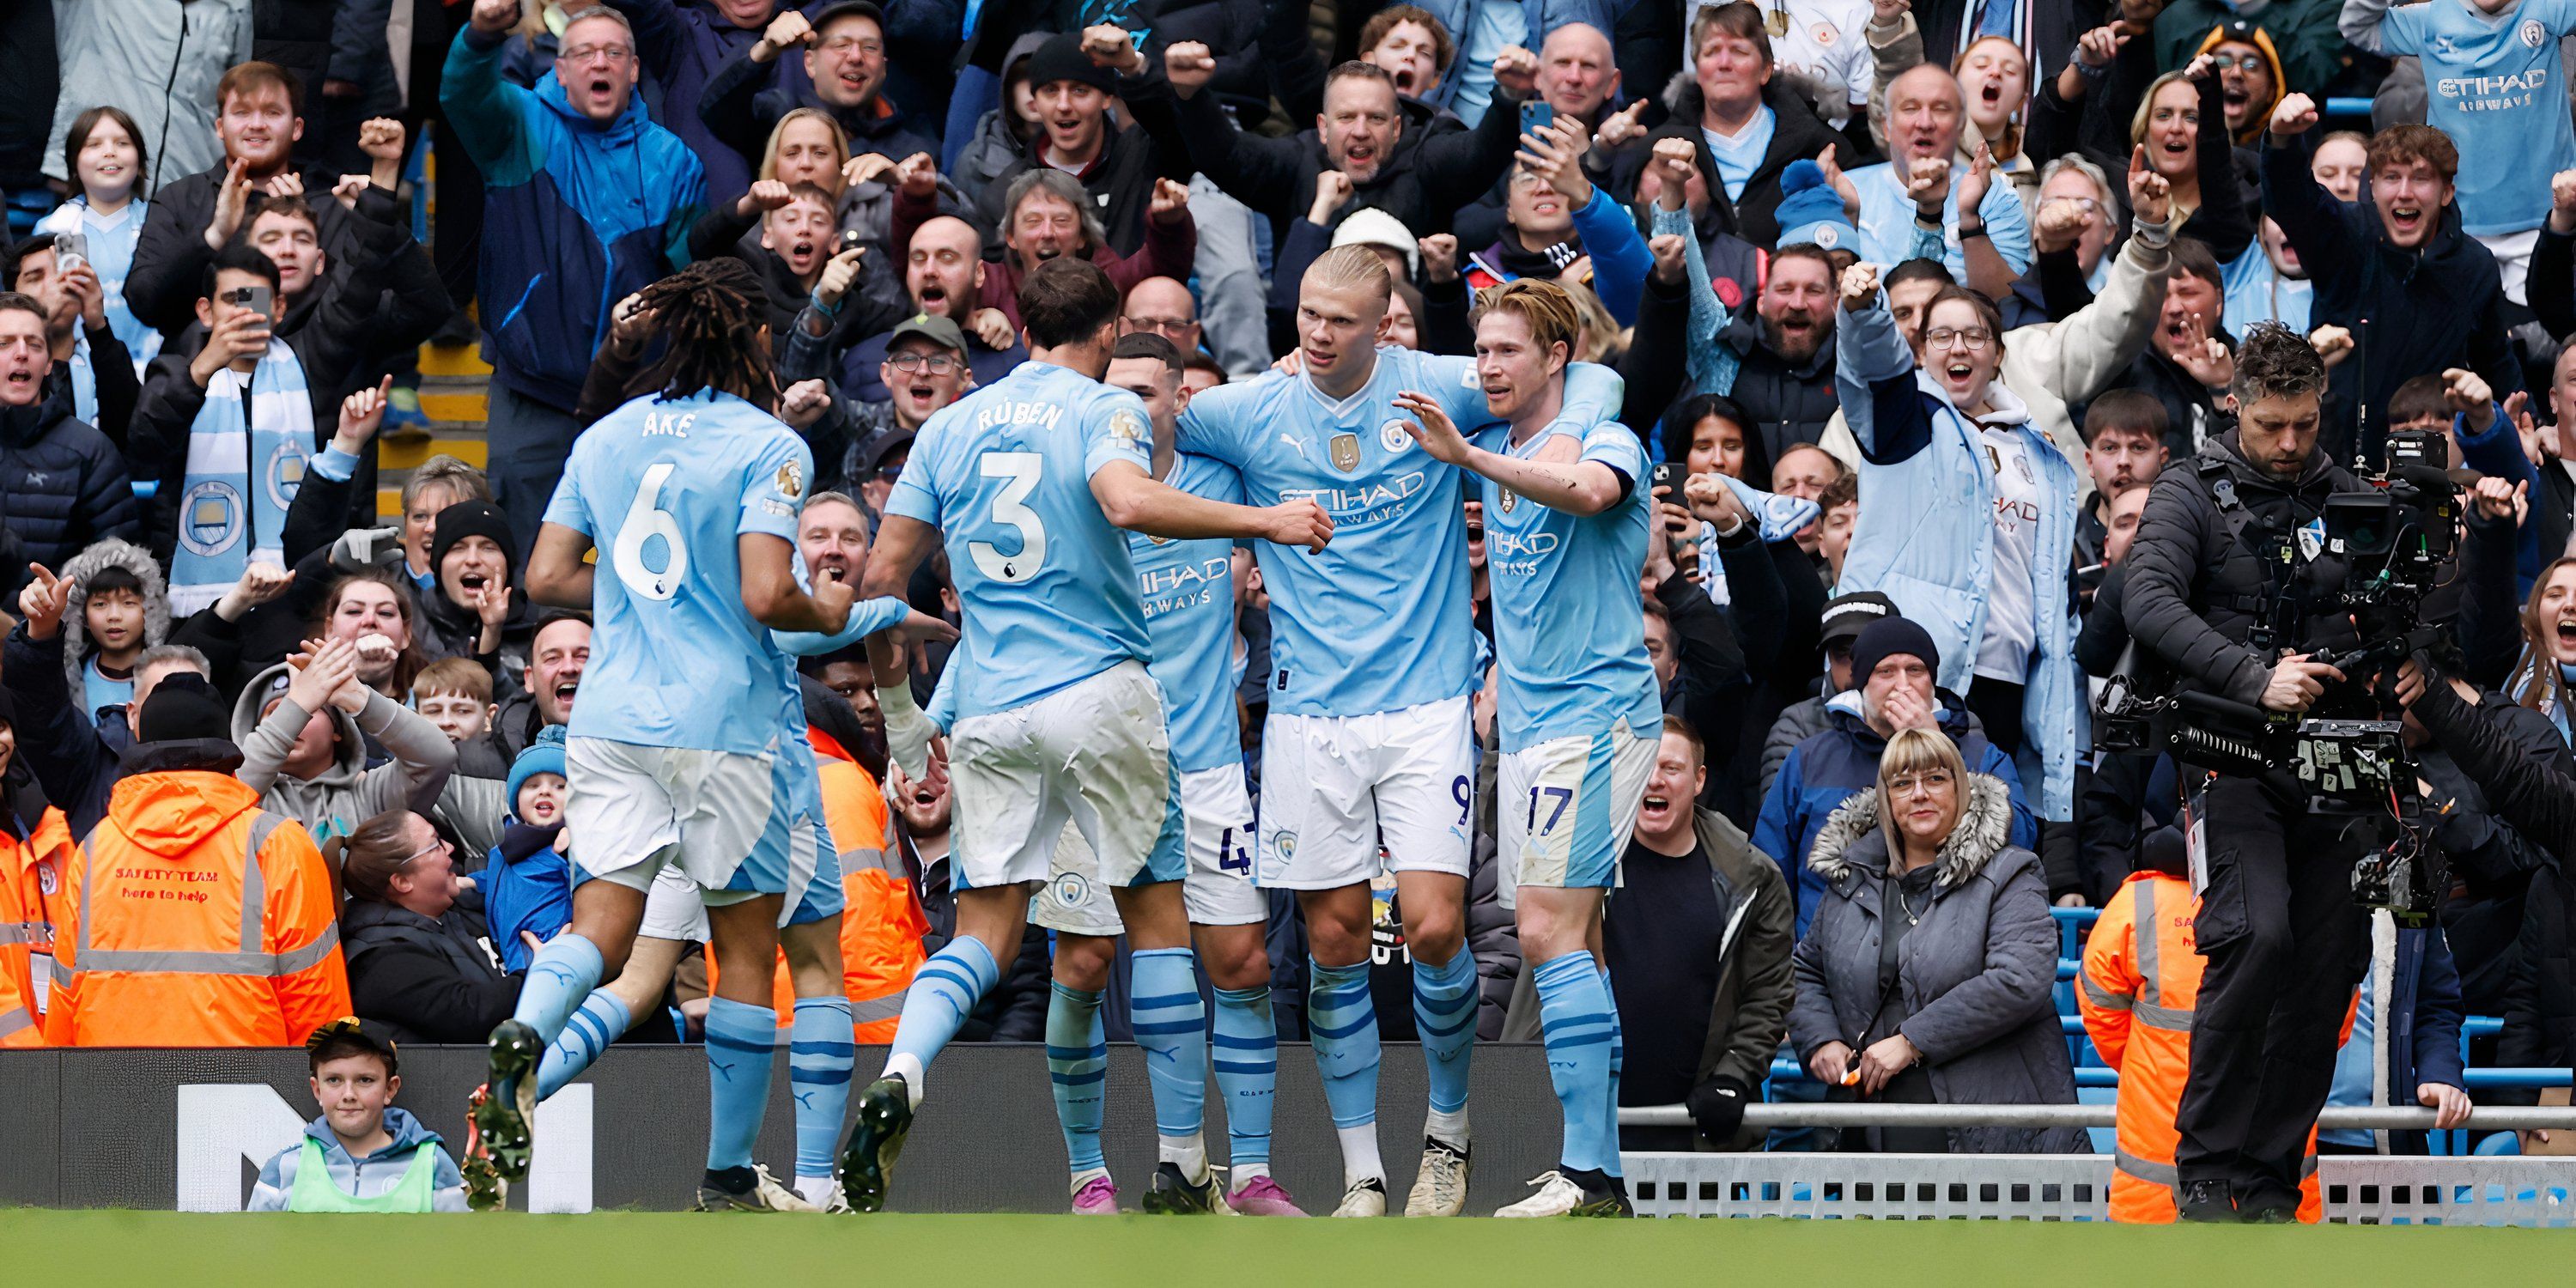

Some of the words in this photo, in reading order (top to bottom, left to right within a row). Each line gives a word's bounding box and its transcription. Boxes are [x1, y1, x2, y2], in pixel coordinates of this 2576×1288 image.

[2438, 69, 2546, 98] ETIHAD
[977, 396, 1064, 432] RÚBEN
[612, 463, 687, 601] 6
[968, 452, 1047, 583] 3
[1451, 775, 1471, 826] 9
[1527, 786, 1573, 836] 17
